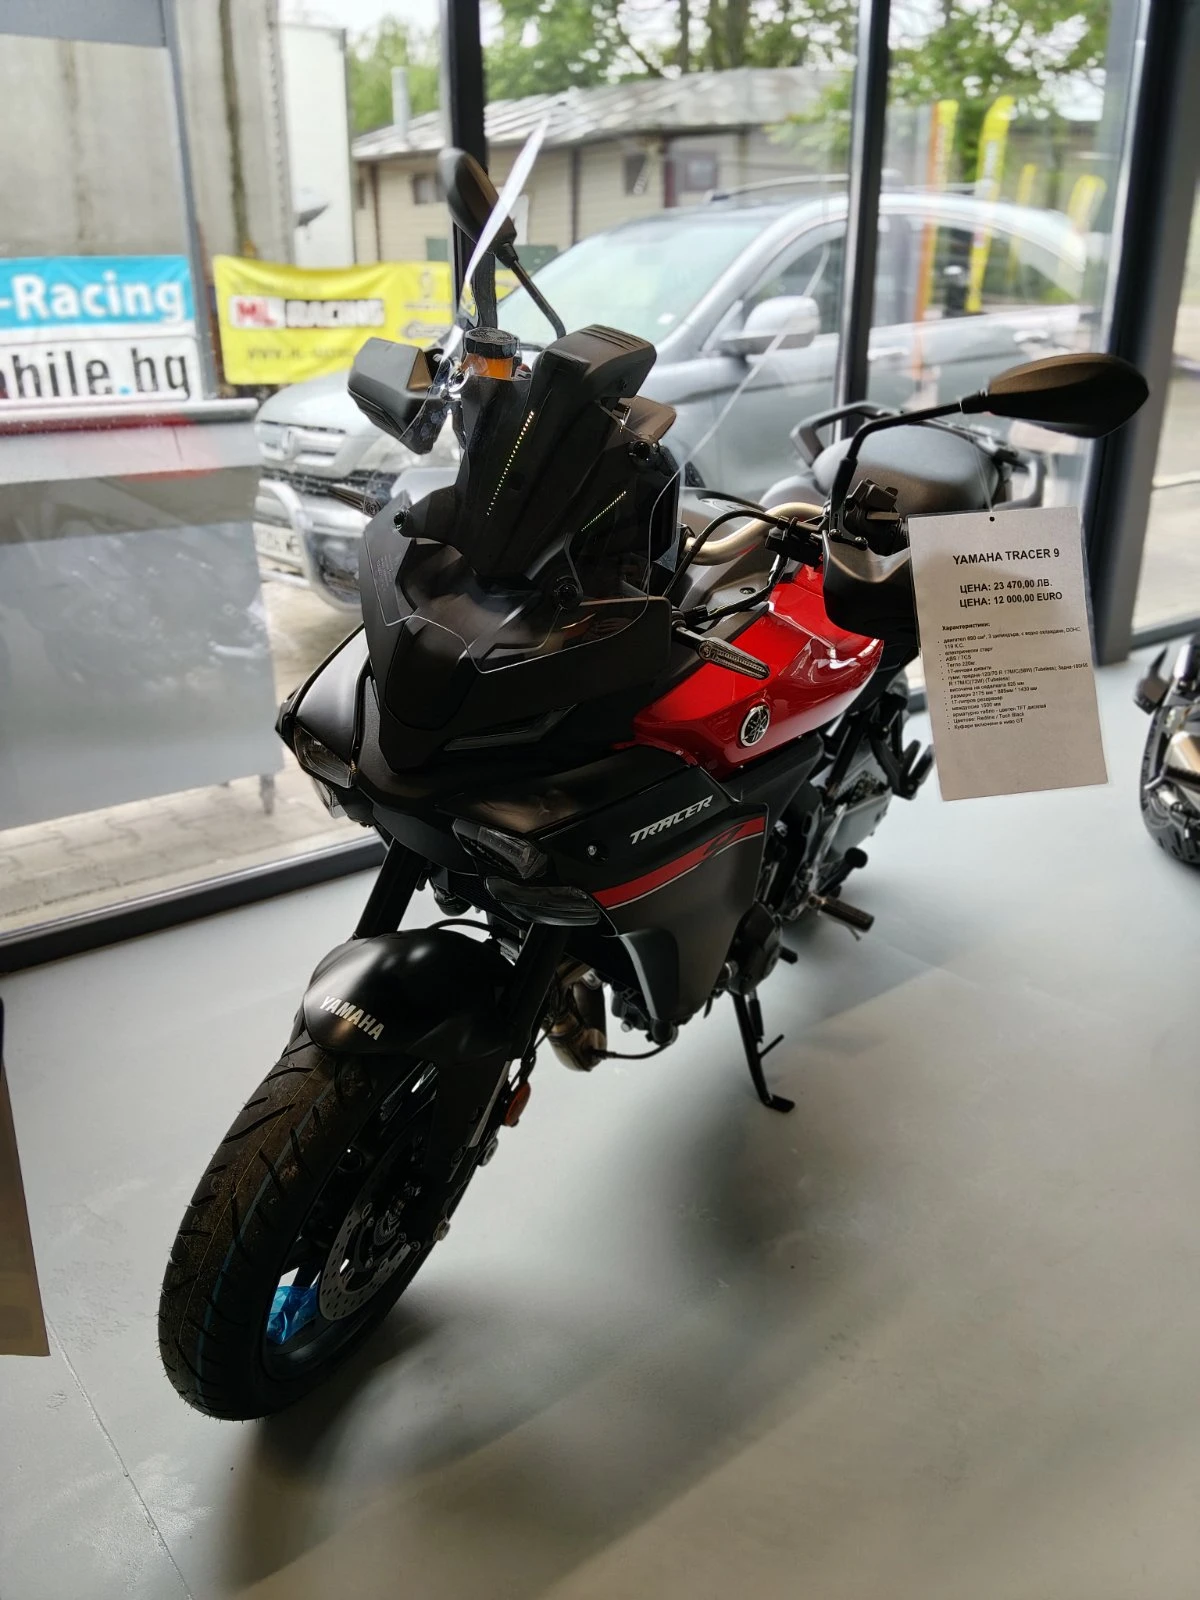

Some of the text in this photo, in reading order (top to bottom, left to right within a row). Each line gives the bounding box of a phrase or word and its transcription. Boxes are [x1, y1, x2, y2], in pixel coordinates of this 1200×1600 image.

[952, 548, 1060, 564] YAMAHA TRACER 9
[959, 578, 1053, 594] ЦЕНА: 23 470,00 ЛВ.
[959, 592, 1063, 608] ЦЕНА: 12 000,00 EURO
[630, 795, 713, 844] TRACER
[320, 996, 384, 1040] YAMAHA
